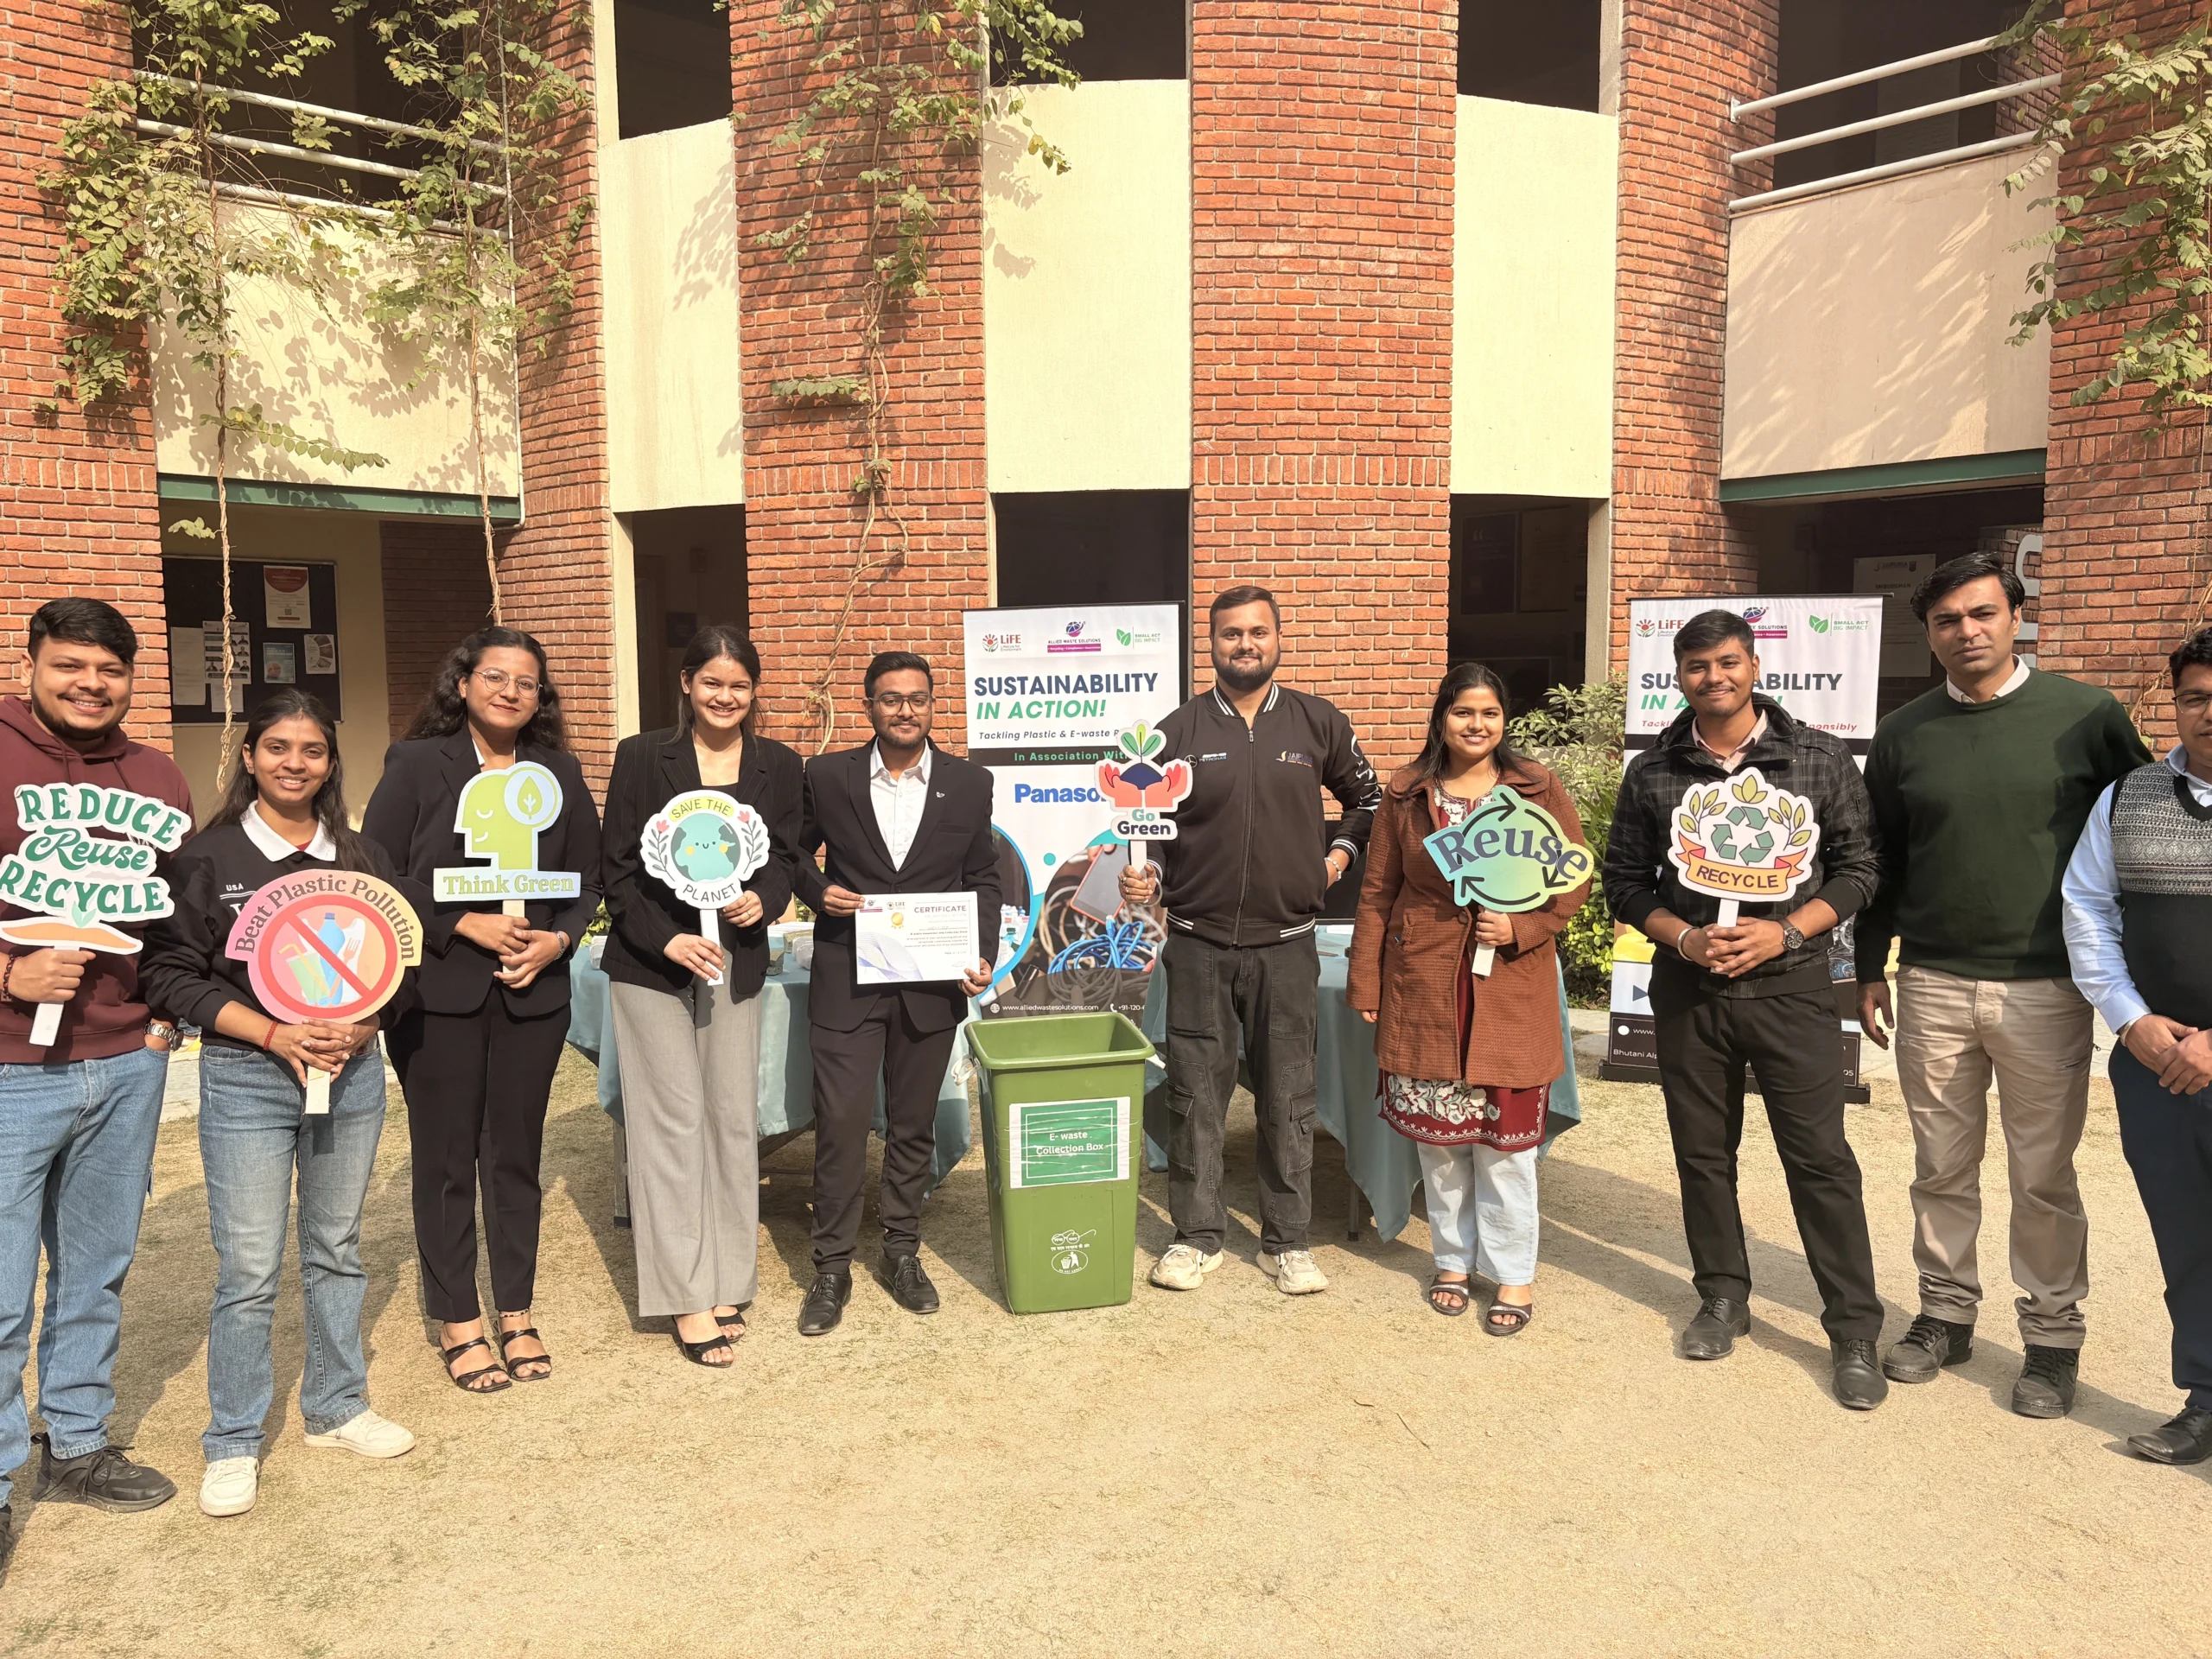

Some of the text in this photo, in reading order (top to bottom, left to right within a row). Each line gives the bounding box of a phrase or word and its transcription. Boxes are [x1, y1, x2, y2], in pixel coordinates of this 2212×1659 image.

[1658, 619, 1685, 629] LiFE
[1001, 634, 1021, 644] LiFE
[975, 673, 1158, 696] SUSTAINABILITY
[976, 699, 1106, 720] IN ACTION!
[1641, 695, 1661, 709] IN
[979, 732, 1020, 741] Tackling
[1023, 730, 1057, 739] Plastic
[1070, 729, 1110, 738] E-waste
[1014, 753, 1025, 761] In
[1029, 751, 1099, 761] Association
[1014, 784, 1106, 804] Panaso
[20, 788, 181, 844] REDUCE
[671, 798, 731, 818] SAVE THE
[1132, 809, 1155, 822] Go
[1117, 821, 1171, 835] Green
[25, 825, 149, 871] Reuse
[1431, 828, 1587, 880] Reuse
[443, 874, 574, 894] Think Green
[1696, 865, 1779, 888] RECYCLE
[0, 860, 164, 914] RECYCLE
[683, 883, 736, 902] PLANET
[235, 874, 416, 961] Beat Plastic Pollution
[914, 905, 967, 913] CERTIFICATE
[1613, 1048, 1645, 1058] Bhutani
[1049, 1130, 1088, 1141] E- waste
[1036, 1142, 1104, 1156] Collection Box
